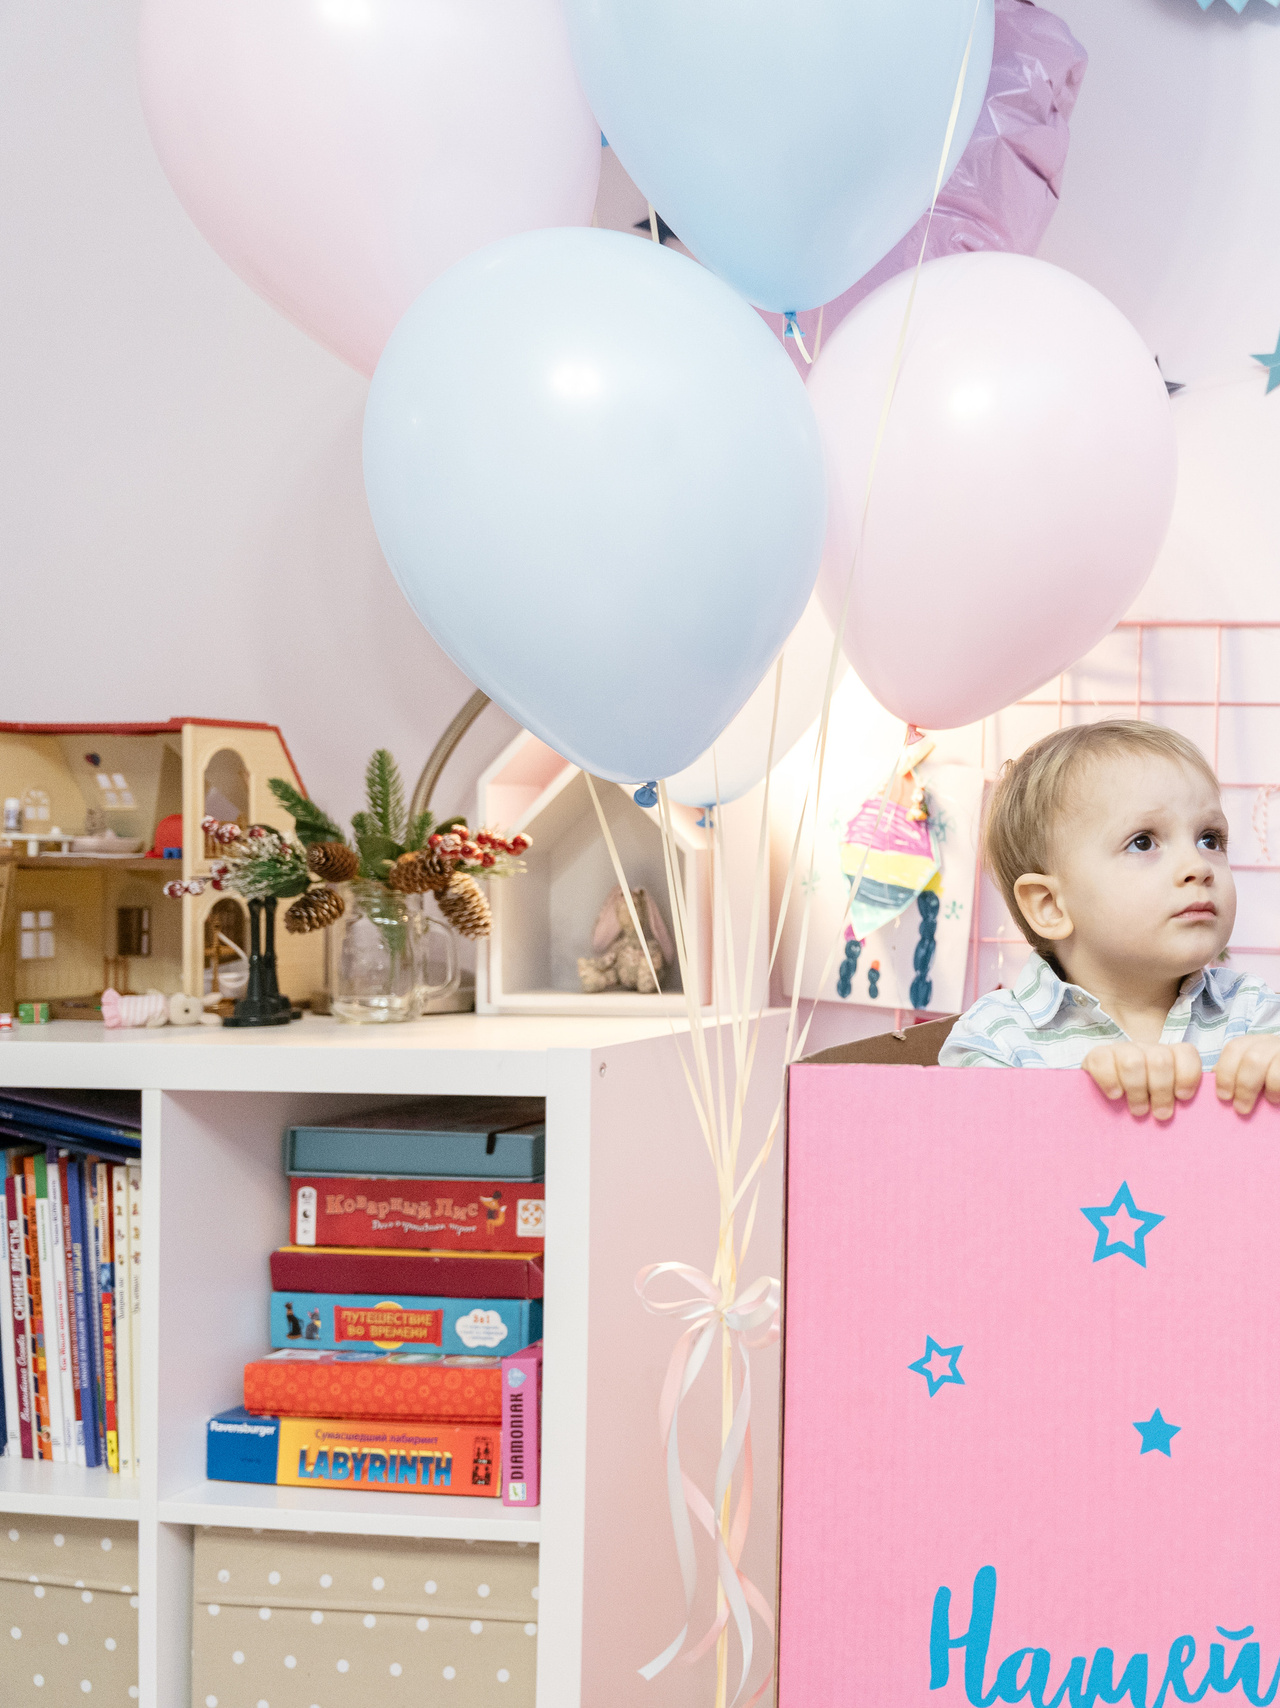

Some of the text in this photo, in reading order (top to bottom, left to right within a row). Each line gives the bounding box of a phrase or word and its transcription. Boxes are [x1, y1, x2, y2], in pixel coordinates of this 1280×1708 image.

[325, 1193, 479, 1221] Коварный Лис
[9, 1219, 25, 1321] СИНИЕ ЛИСТЬЯ
[341, 1310, 433, 1326] ПУТЕШЕСТВИЕ
[346, 1325, 428, 1339] ВО ВРЕМЕНИ
[209, 1420, 277, 1438] Ravensburger
[315, 1428, 438, 1446] Сумасшедший лабиринт
[298, 1444, 453, 1486] LABYRINTH
